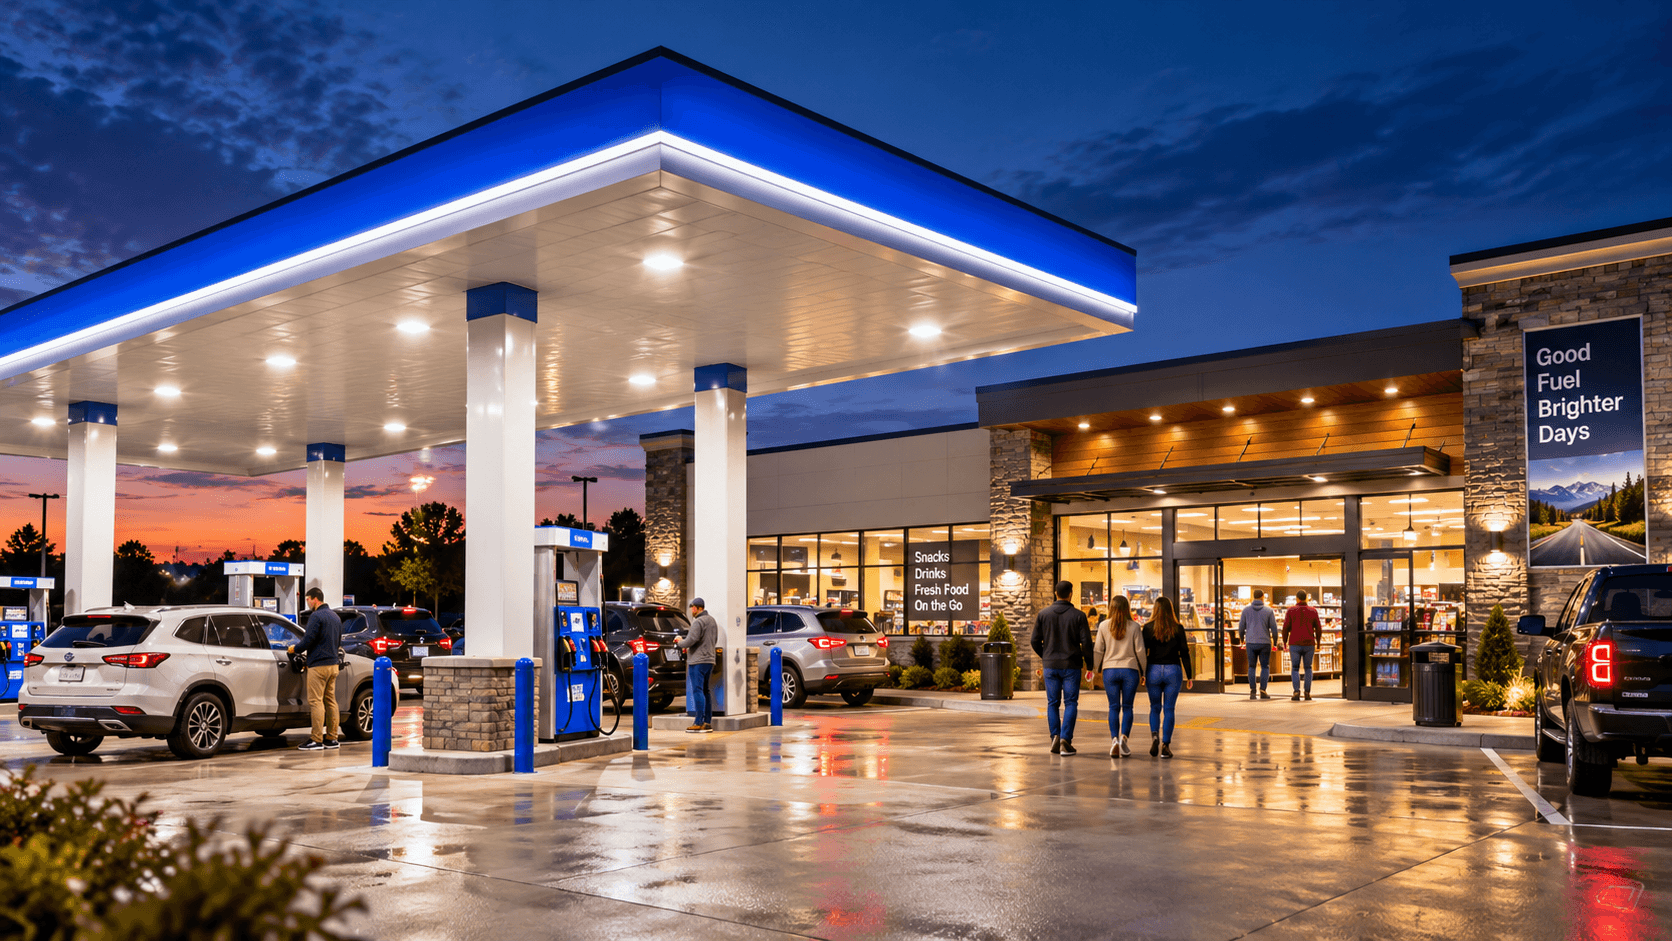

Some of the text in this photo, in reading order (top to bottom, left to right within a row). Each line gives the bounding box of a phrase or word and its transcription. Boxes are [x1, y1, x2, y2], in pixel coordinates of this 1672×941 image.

[1536, 342, 1591, 366] Good
[1537, 369, 1581, 392] Fuel
[1538, 394, 1624, 420] Brighter
[1538, 425, 1591, 446] Days
[914, 550, 950, 563] Snacks
[914, 567, 947, 579] Drinks
[914, 583, 969, 596] Fresh Food
[914, 599, 963, 611] On the Go
